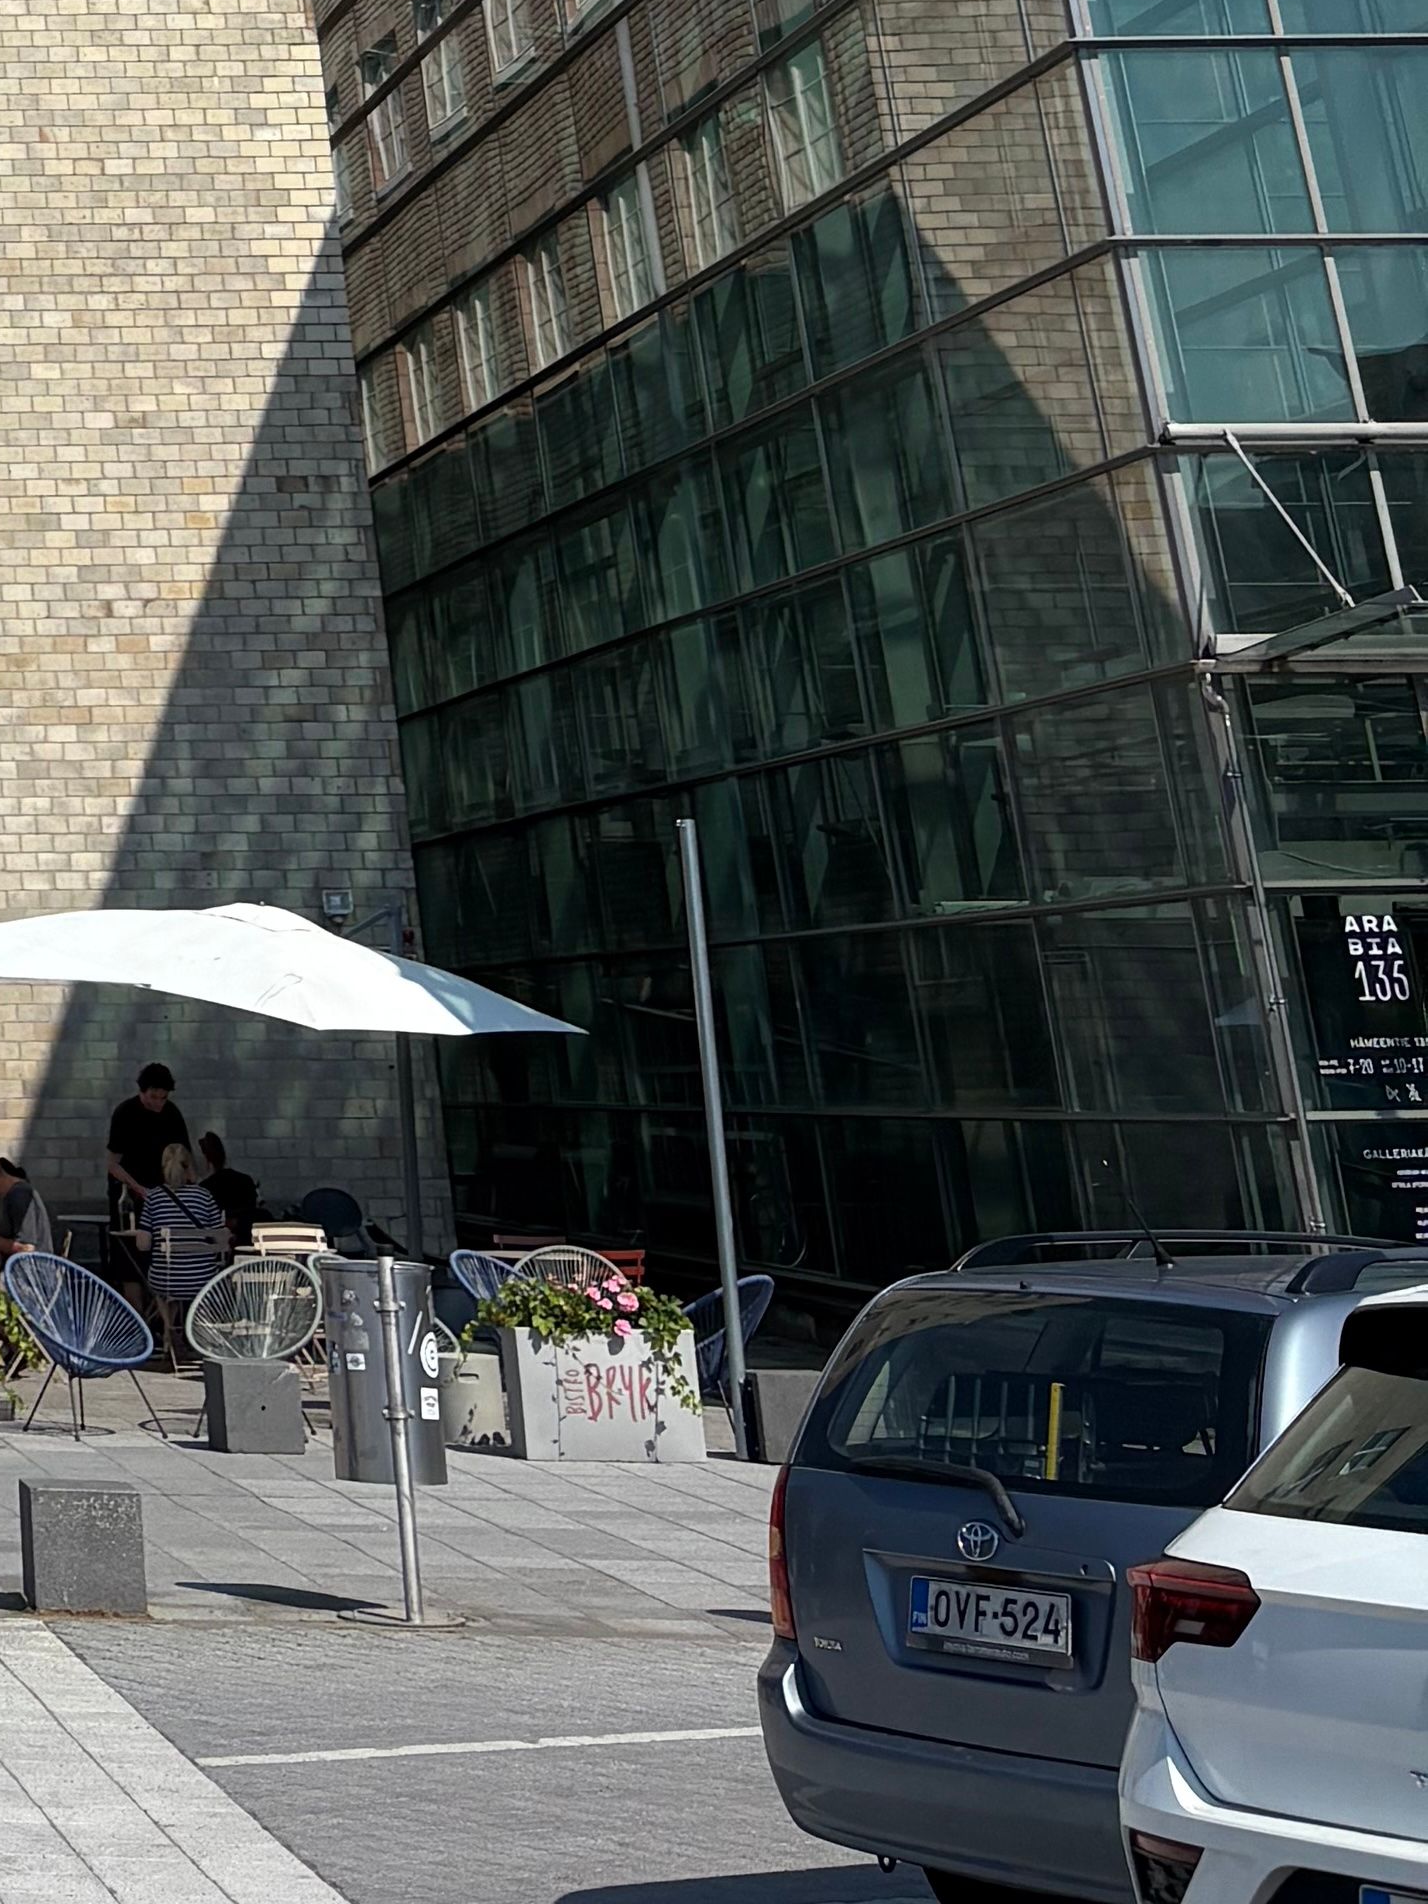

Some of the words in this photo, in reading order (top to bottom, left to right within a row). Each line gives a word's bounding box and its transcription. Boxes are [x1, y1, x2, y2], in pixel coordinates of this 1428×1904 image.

[1344, 915, 1398, 932] ARA
[1347, 937, 1403, 955] BIA
[1354, 960, 1410, 1001] 135
[564, 1369, 587, 1414] BISTRO
[584, 1363, 654, 1423] BRYK
[934, 1589, 1061, 1644] OVF-524
